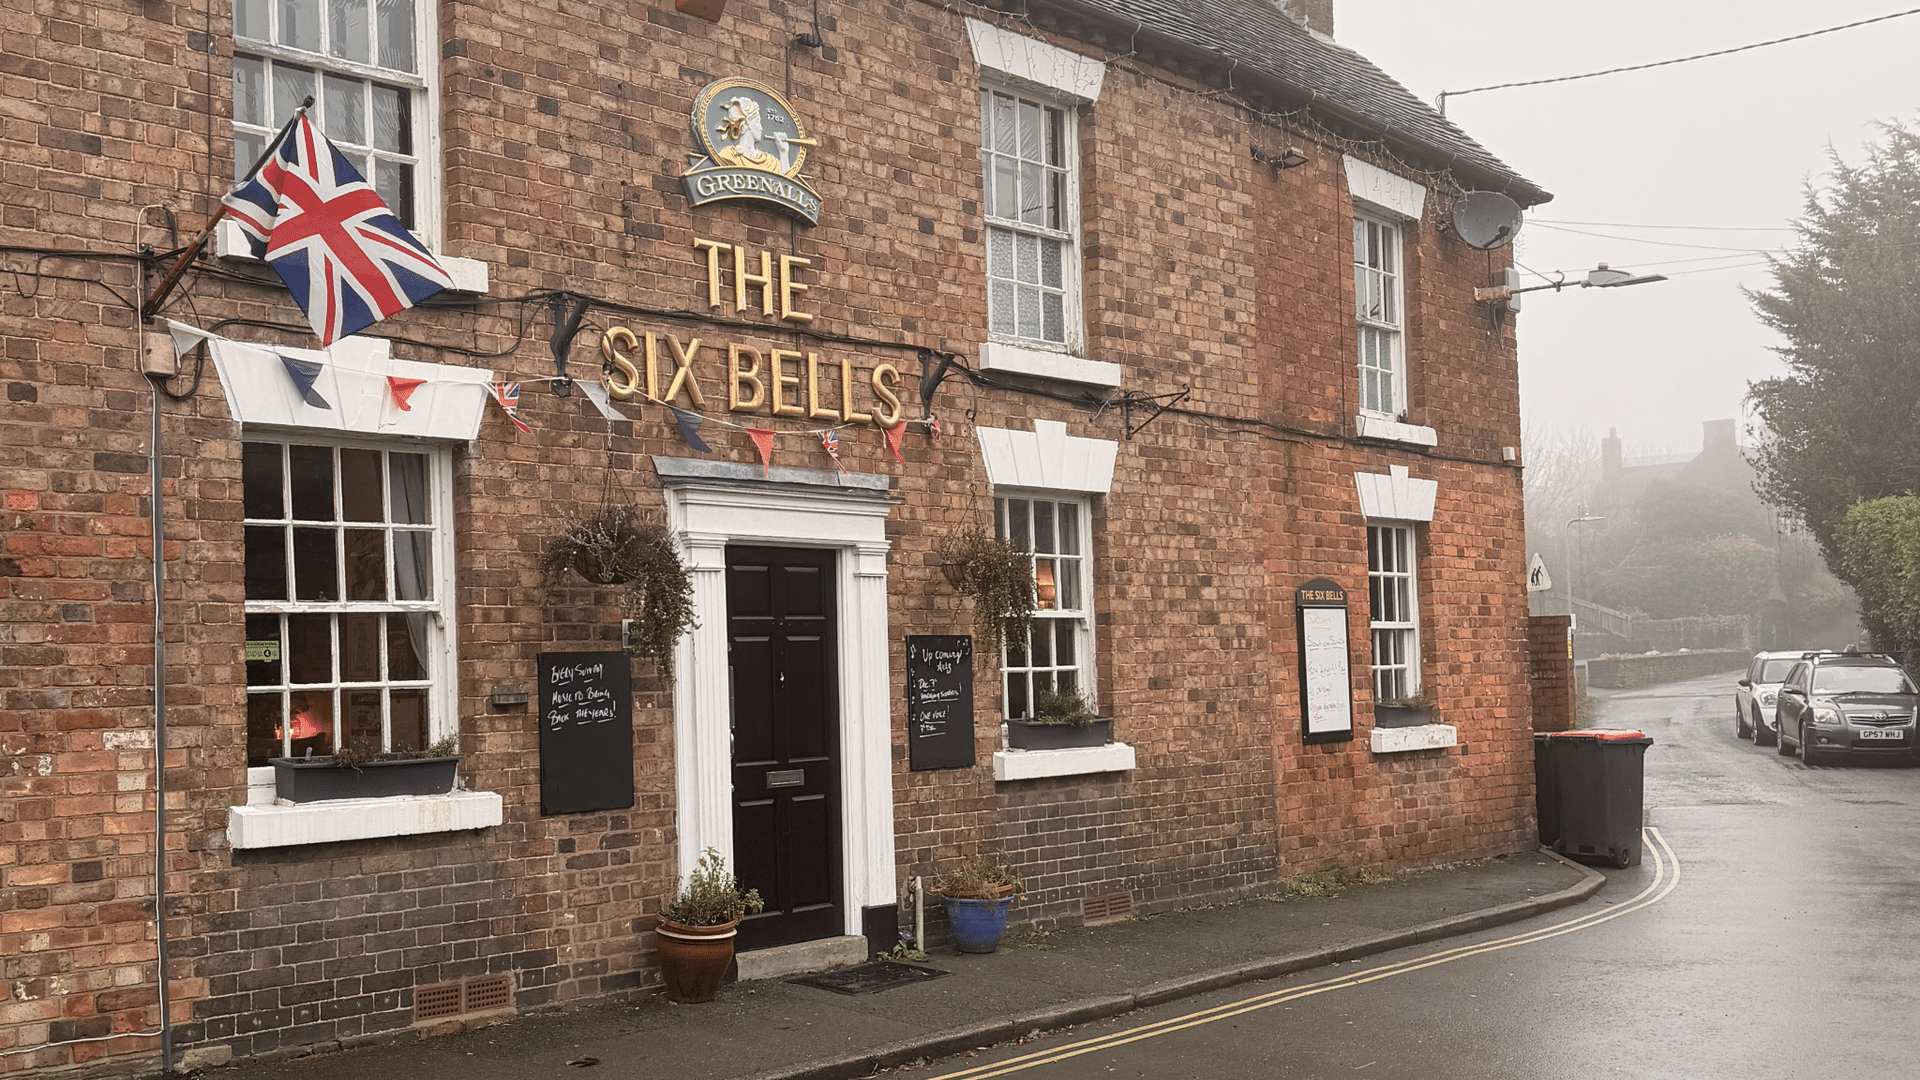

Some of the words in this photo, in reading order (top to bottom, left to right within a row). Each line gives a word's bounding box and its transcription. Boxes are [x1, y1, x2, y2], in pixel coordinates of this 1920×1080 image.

[694, 236, 814, 323] THE
[601, 325, 706, 406] SIX
[727, 342, 902, 429] BELLS
[1301, 589, 1314, 601] THE
[1314, 590, 1326, 601] SIX
[1325, 590, 1344, 601] BELLS
[1863, 730, 1883, 738] GP57
[1885, 730, 1901, 738] WHJ
